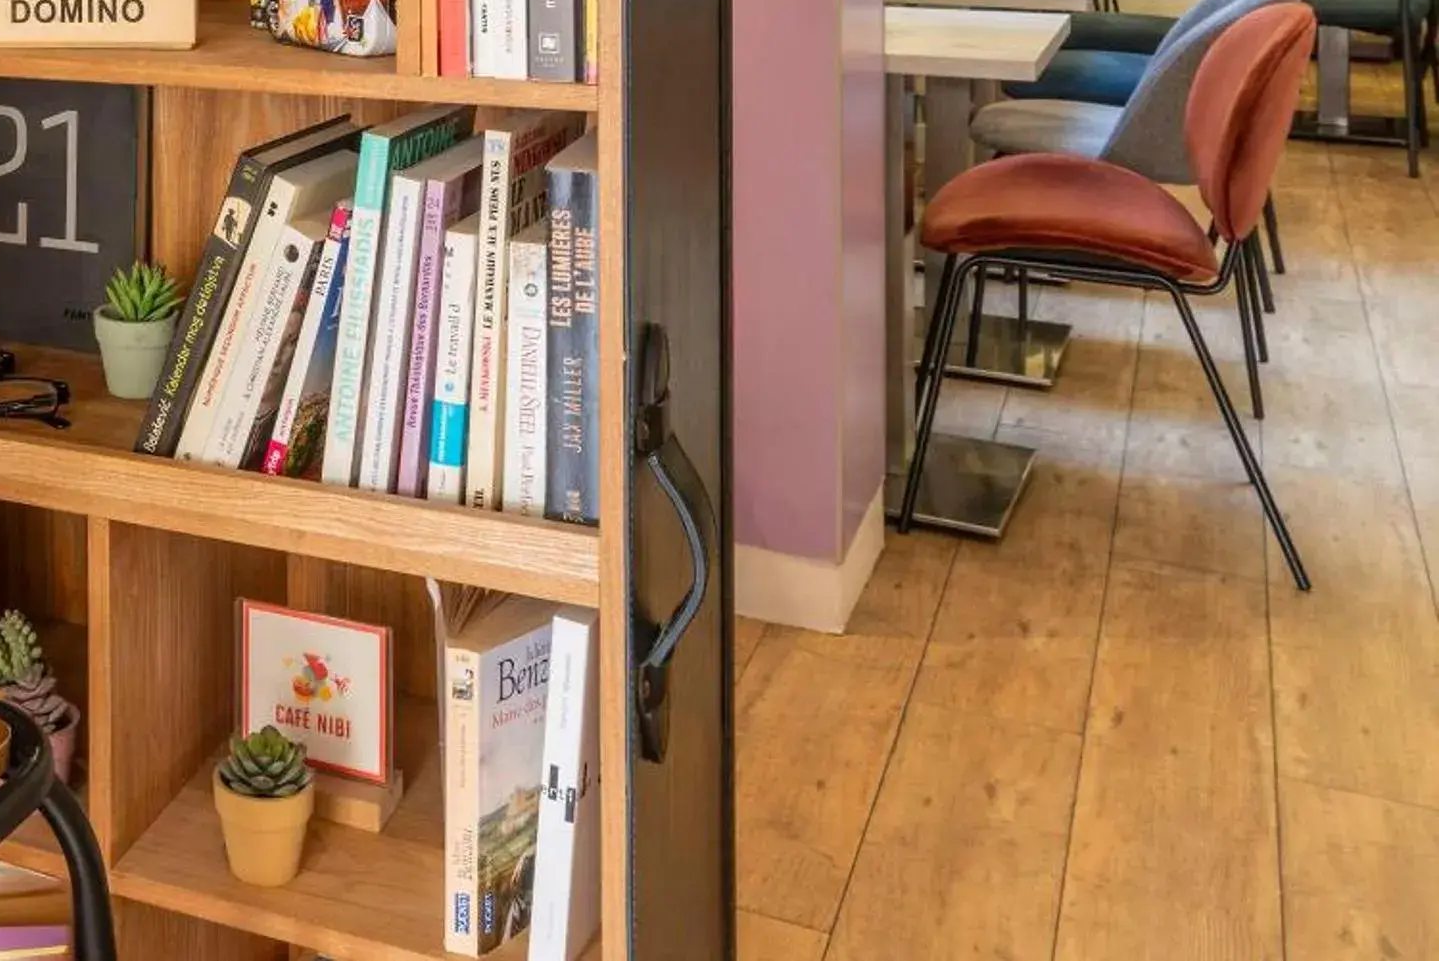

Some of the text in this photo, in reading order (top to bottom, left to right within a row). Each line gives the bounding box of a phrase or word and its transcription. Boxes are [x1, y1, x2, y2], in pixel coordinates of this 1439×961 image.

[314, 252, 334, 297] PARIS
[547, 206, 572, 329] LES LUMIÈRES
[482, 314, 493, 330] LE
[332, 345, 360, 443] ANTOINE
[561, 353, 582, 454] JAX MILLER
[274, 703, 352, 740] CAFÉ NIBI
